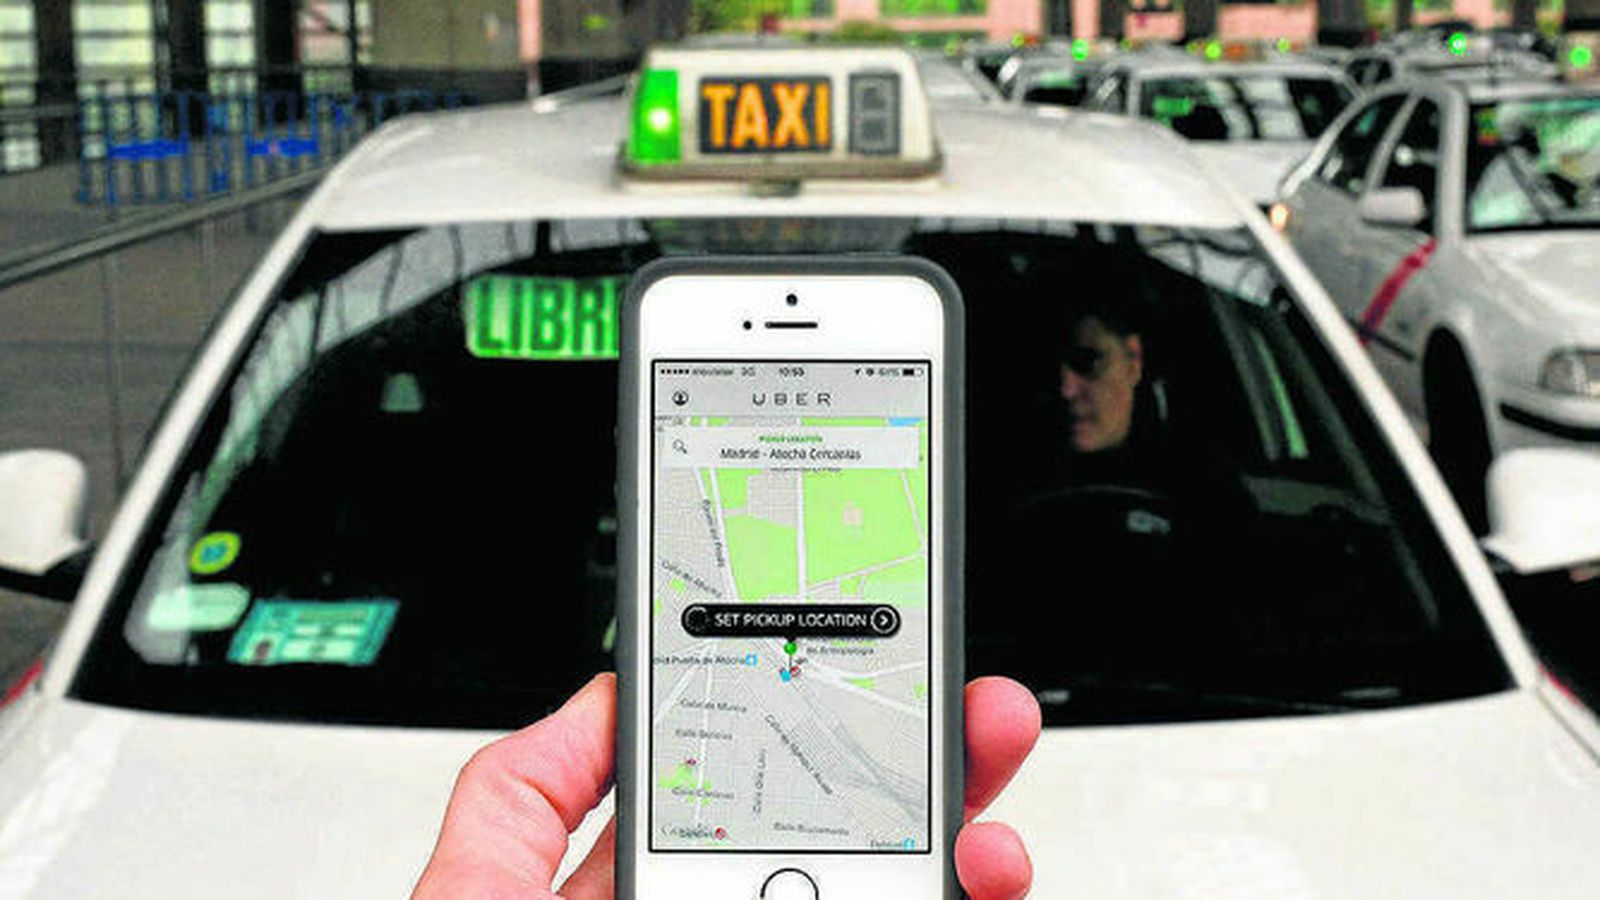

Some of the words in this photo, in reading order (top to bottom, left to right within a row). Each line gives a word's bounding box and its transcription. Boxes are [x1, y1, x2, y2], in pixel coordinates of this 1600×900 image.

[703, 84, 829, 148] TAXI
[752, 393, 831, 406] UBER
[720, 448, 759, 459] Madrid
[769, 448, 806, 460] Atocha
[714, 613, 740, 627] SET
[743, 613, 795, 627] PICKUP
[798, 613, 867, 627] LOCATION
